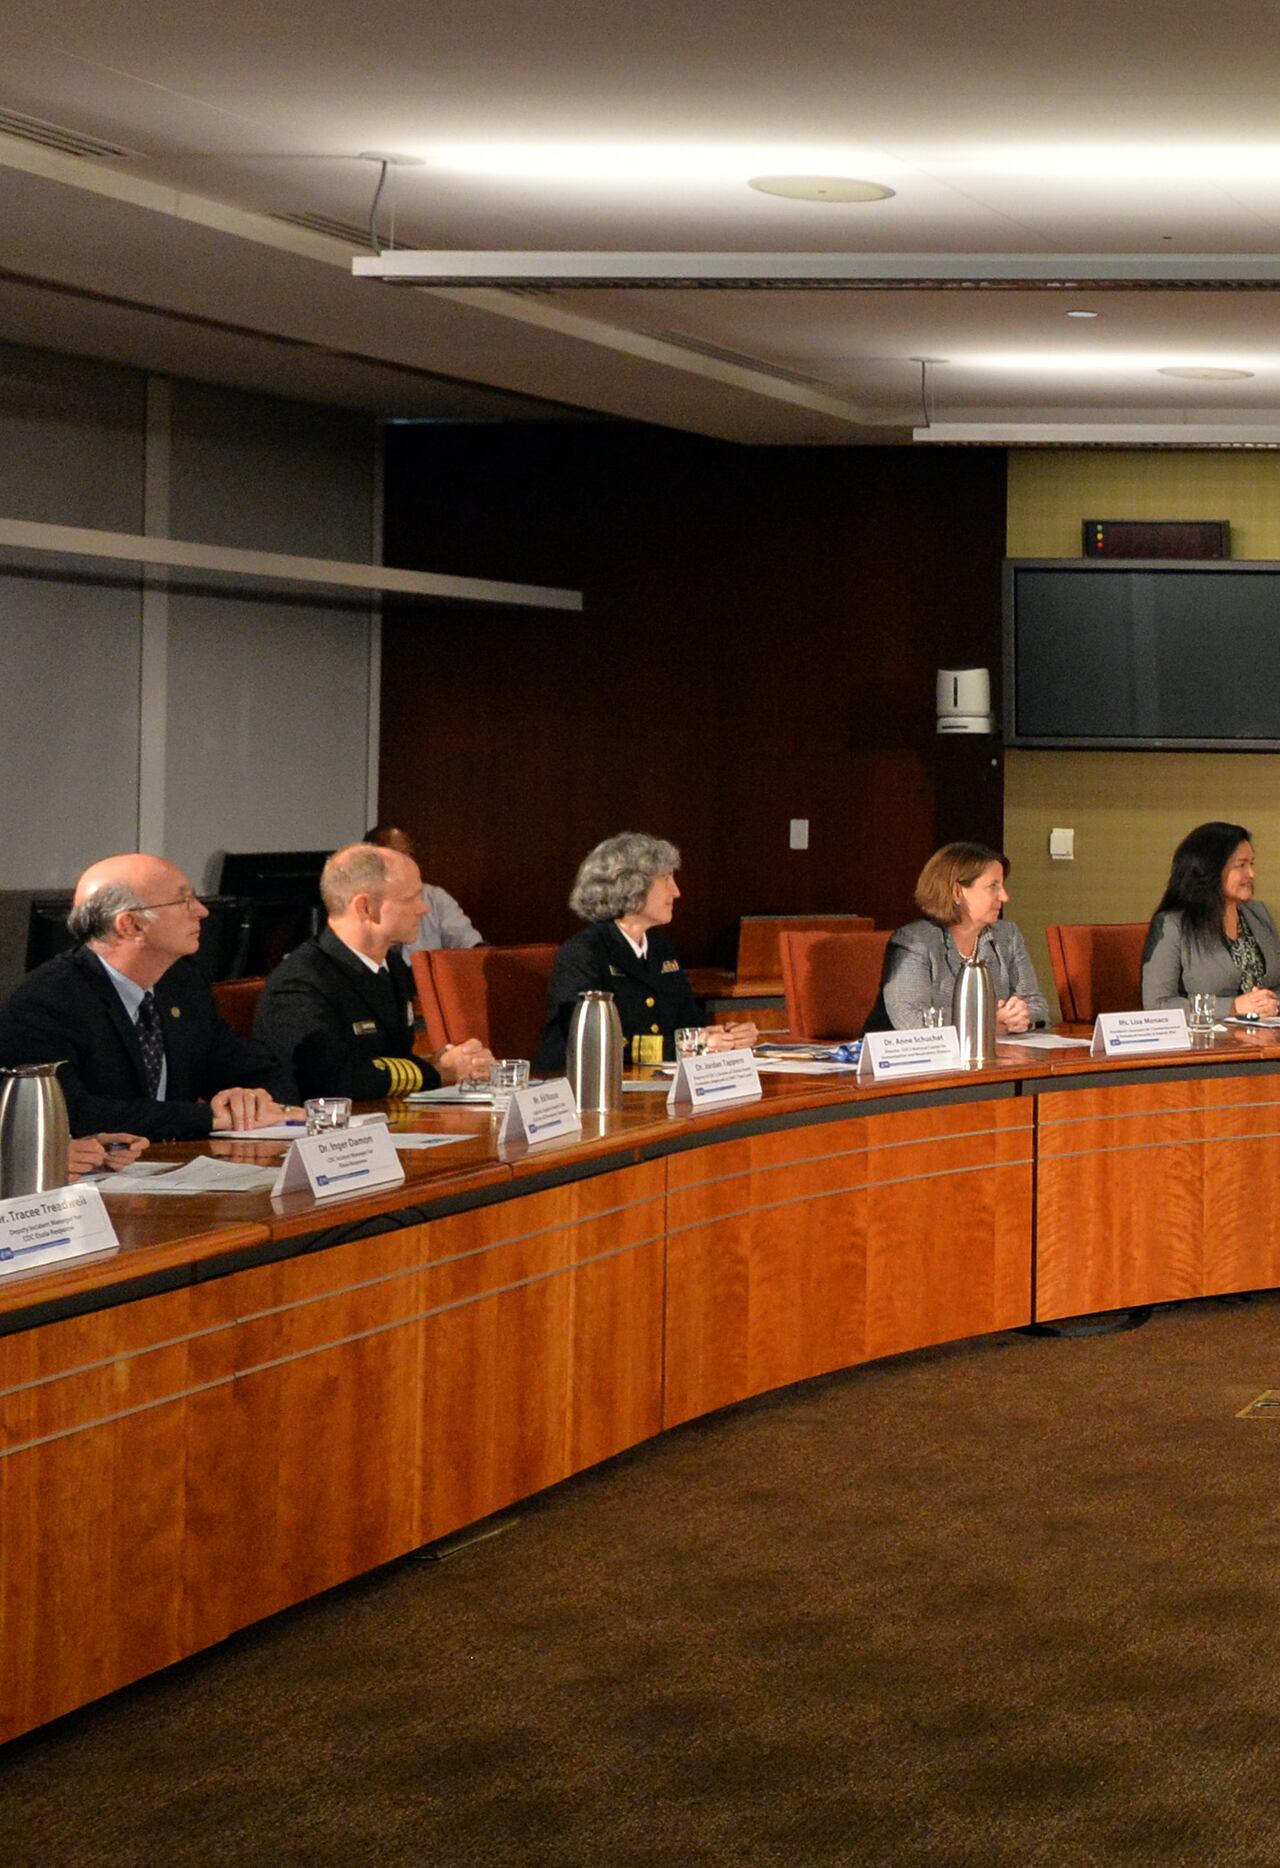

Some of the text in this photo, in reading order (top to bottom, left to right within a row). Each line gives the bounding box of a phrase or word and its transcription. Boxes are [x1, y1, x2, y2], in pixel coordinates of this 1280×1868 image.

[1130, 1017, 1143, 1025] Lisa
[1144, 1016, 1169, 1024] Monaco
[884, 1034, 944, 1047] Dr. Anne Schuchat
[318, 1136, 373, 1153] Dr. Inger Damon
[8, 1208, 41, 1222] Tracee
